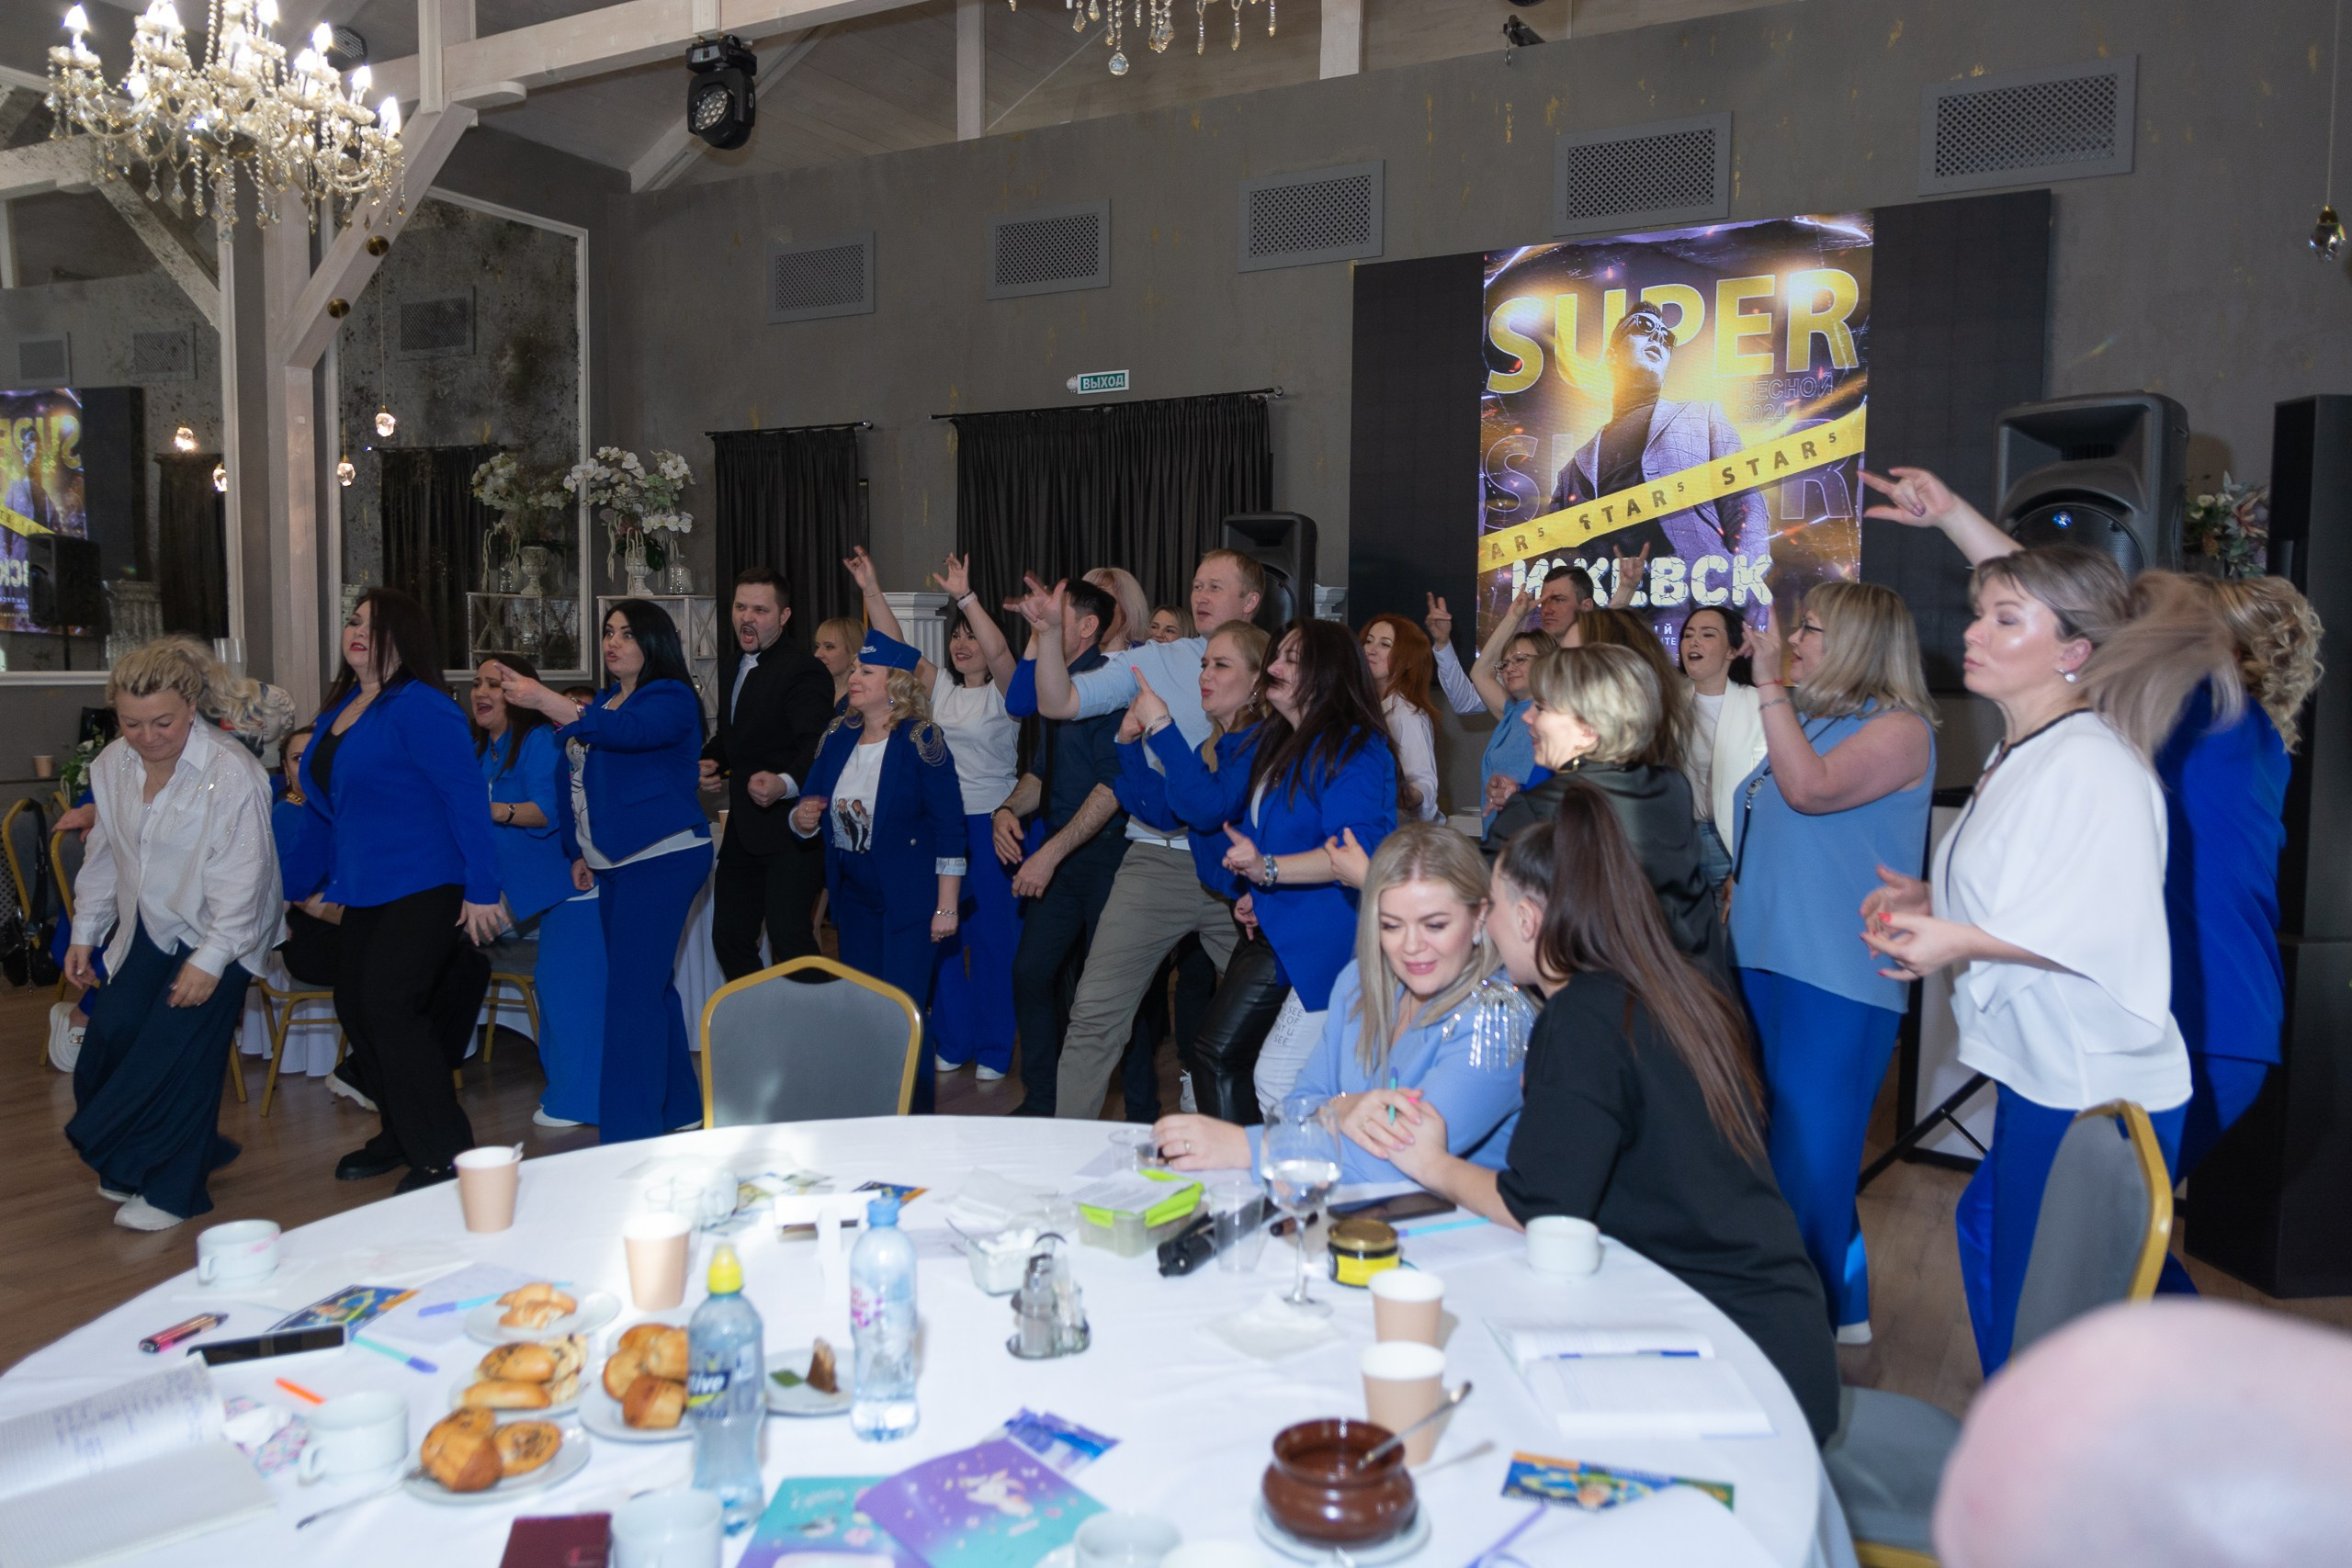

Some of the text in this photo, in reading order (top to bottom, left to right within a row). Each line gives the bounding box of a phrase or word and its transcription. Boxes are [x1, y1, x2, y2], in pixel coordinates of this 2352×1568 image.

[1487, 268, 1859, 394] SUPER
[1082, 375, 1124, 389] ВЫХОД
[1740, 371, 1833, 401] ВЕСНОЙ
[1742, 402, 1786, 423] 2024
